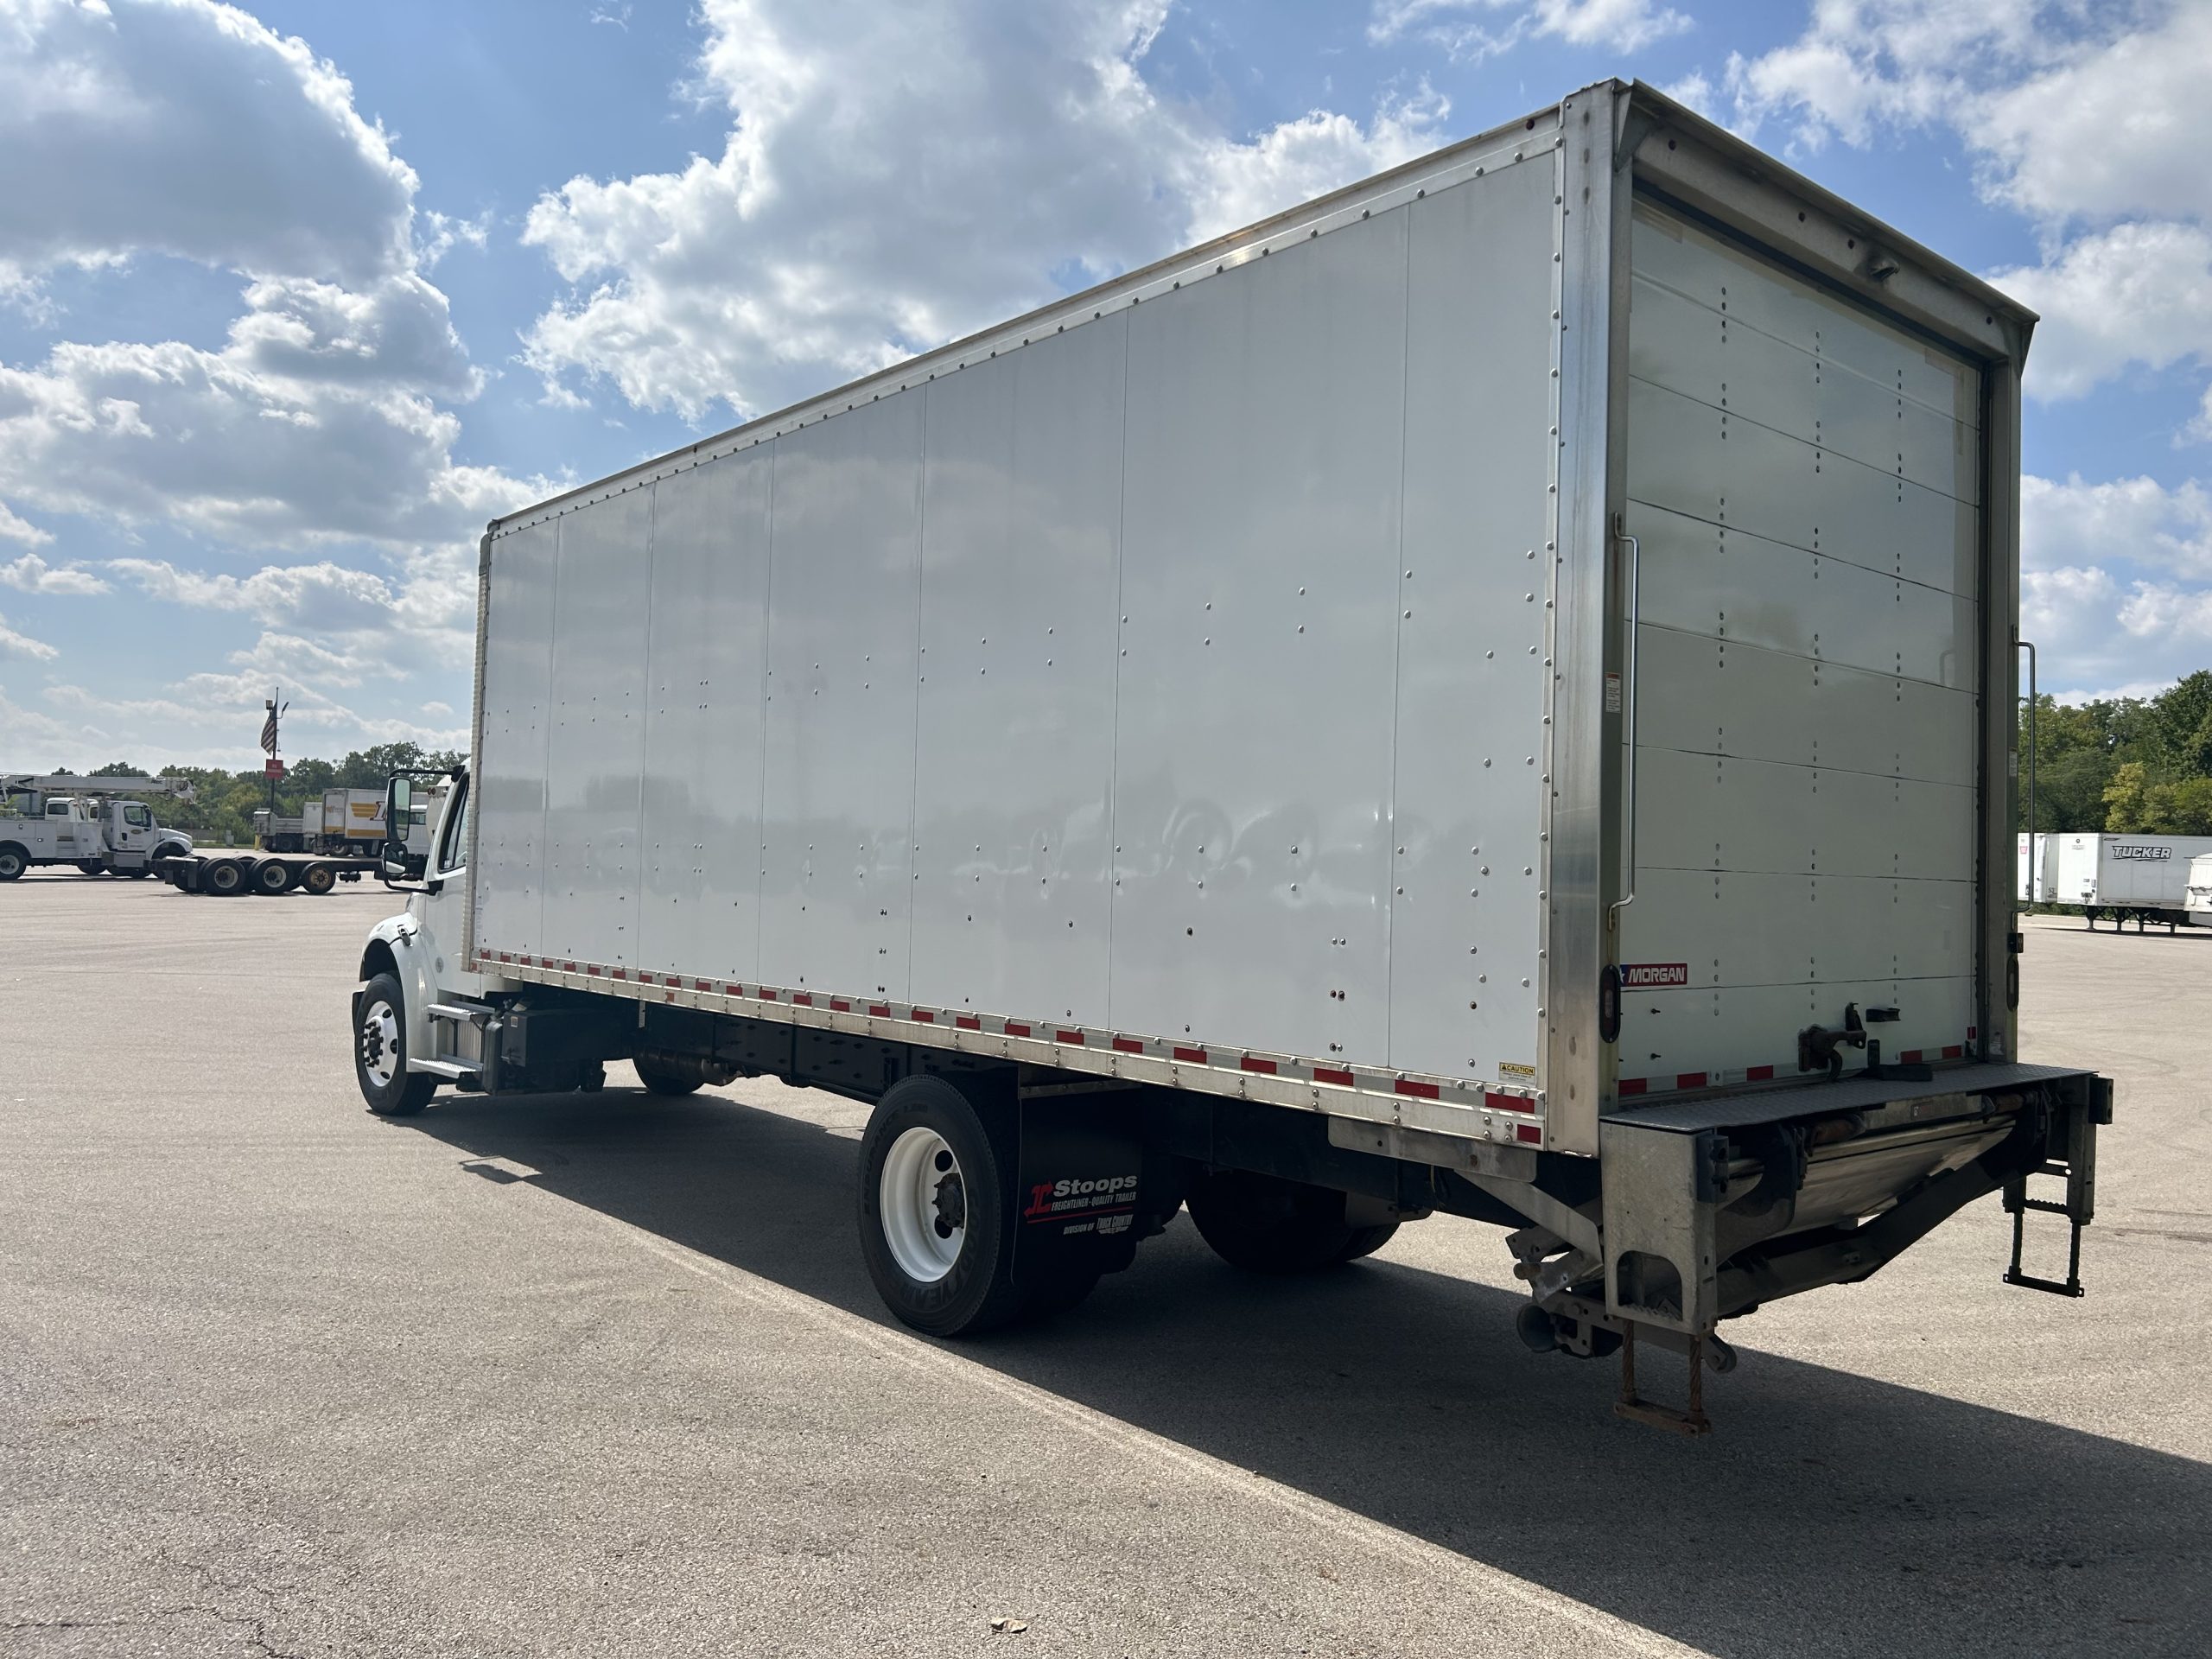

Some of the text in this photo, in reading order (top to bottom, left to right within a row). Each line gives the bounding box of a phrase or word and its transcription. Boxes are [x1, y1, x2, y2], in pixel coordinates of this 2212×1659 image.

[2112, 845, 2171, 860] TUCKER
[1628, 967, 1685, 983] MORGAN
[1506, 1065, 1534, 1074] CAUTION
[1052, 1175, 1138, 1198] Stoops
[1115, 1192, 1137, 1203] TRAILER
[1063, 1224, 1087, 1236] DIVISION
[1087, 1222, 1096, 1231] OF
[1096, 1217, 1112, 1230] TRUCK
